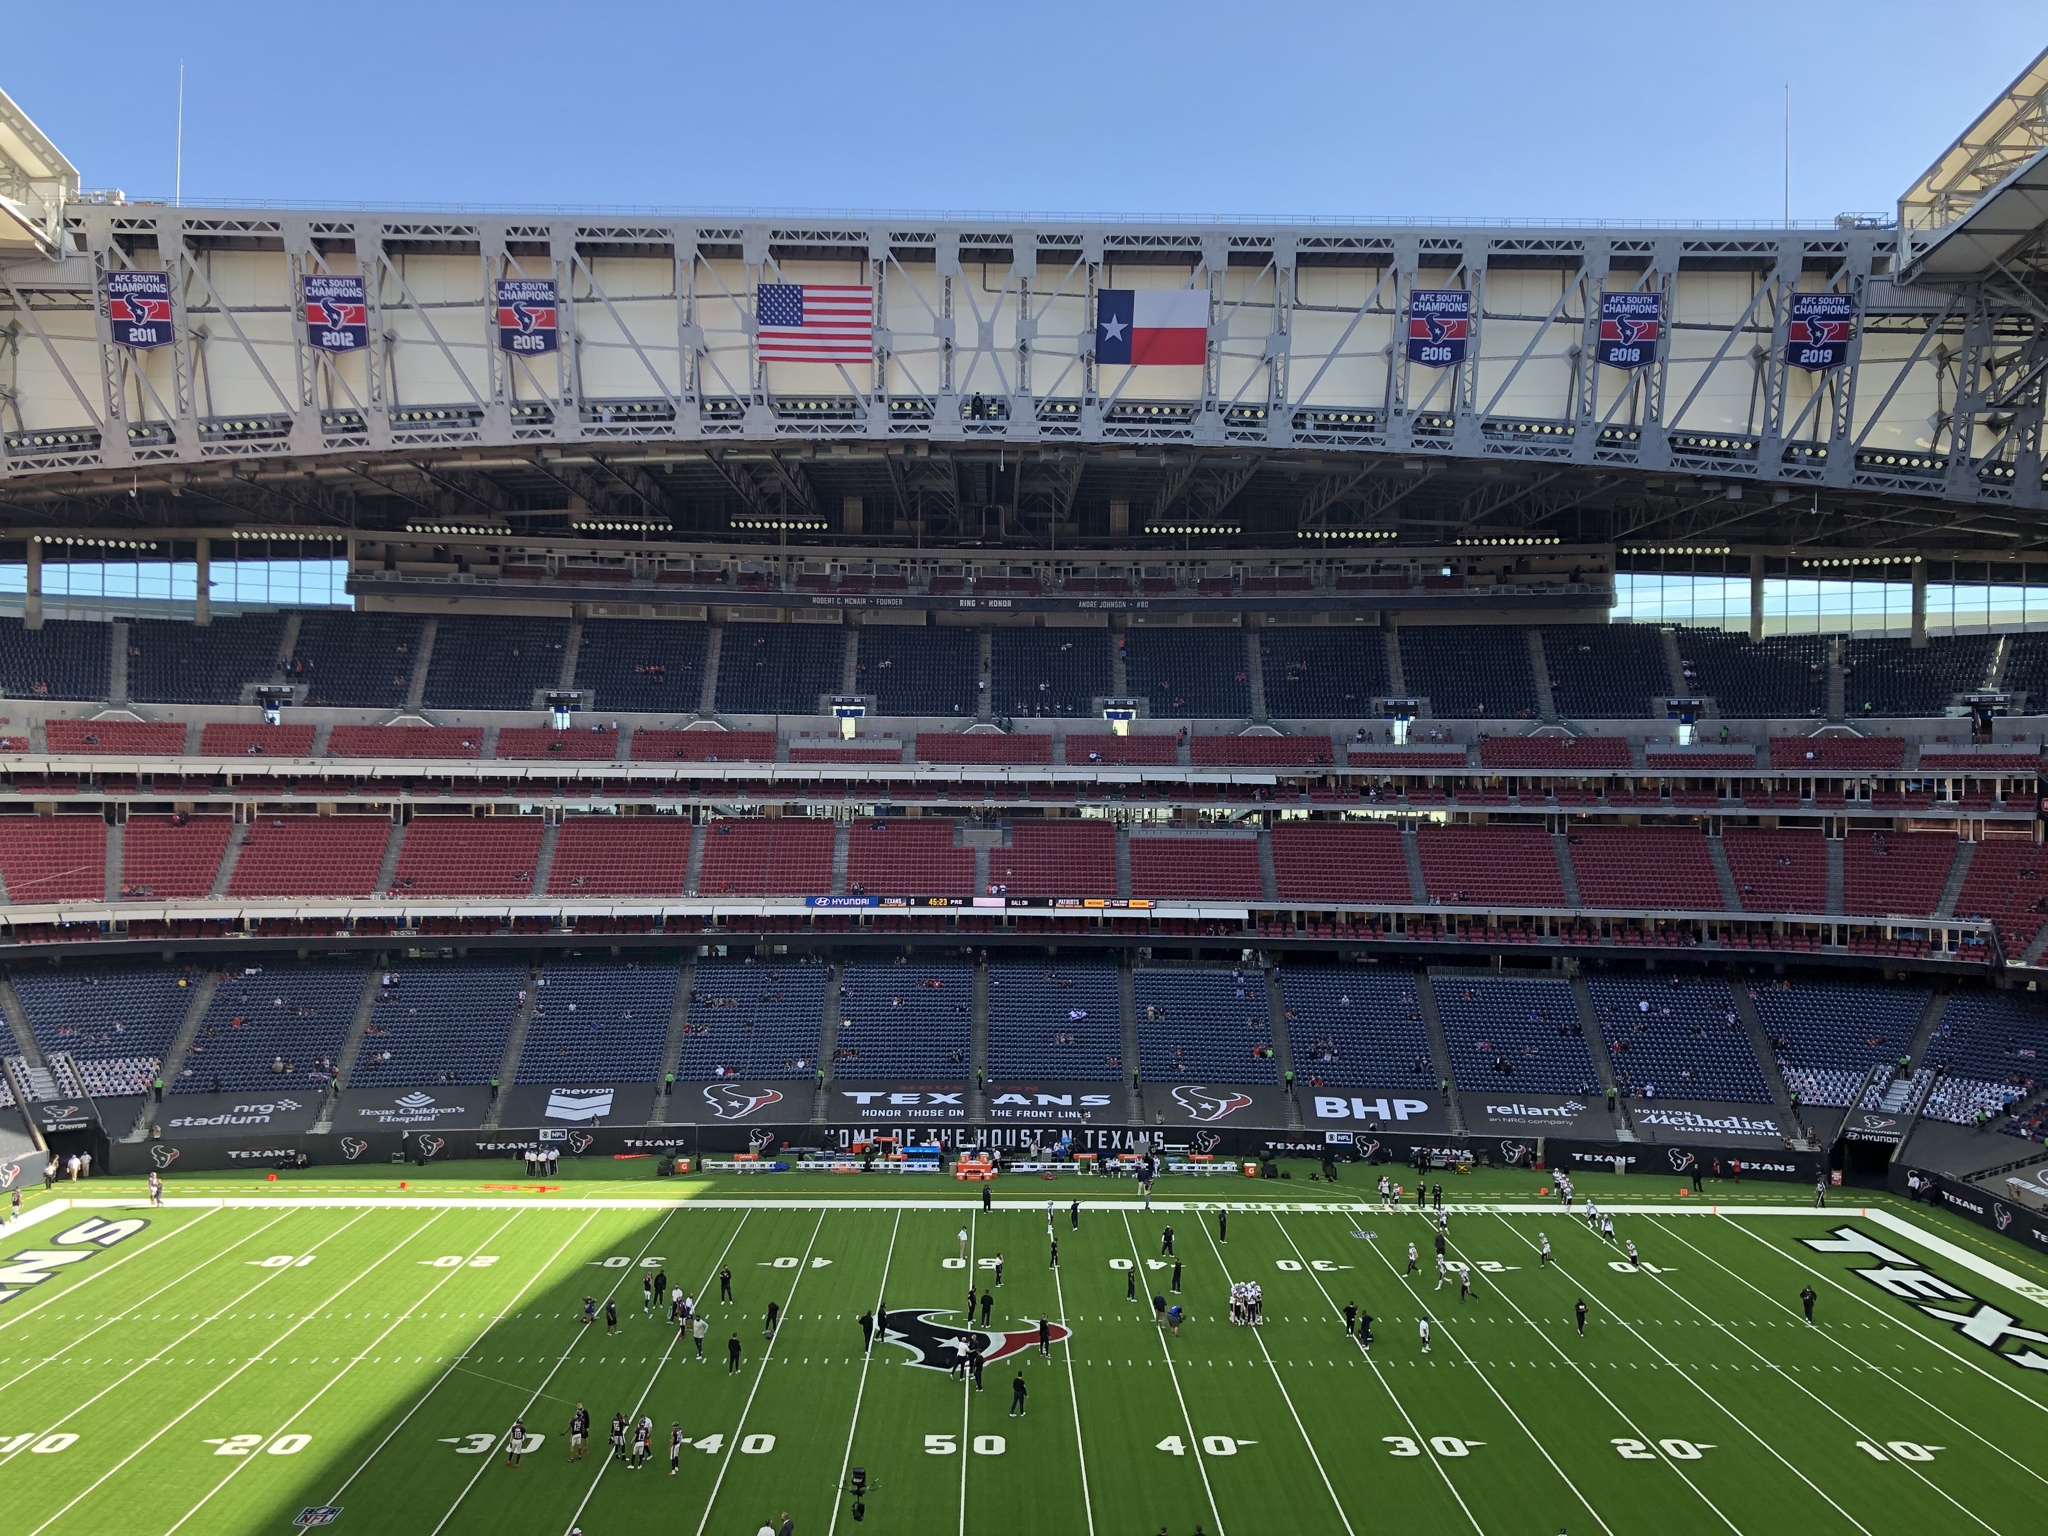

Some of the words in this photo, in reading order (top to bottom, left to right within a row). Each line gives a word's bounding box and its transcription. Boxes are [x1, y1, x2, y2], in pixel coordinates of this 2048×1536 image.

[110, 283, 166, 293] CHAMPIONS
[306, 286, 362, 297] CHAMPIONS
[498, 291, 554, 300] CHAMPIONS
[1413, 302, 1468, 312] CHAMPIONS
[1603, 304, 1658, 313] CHAMPIONS
[1794, 305, 1850, 314] CHAMPIONS
[128, 328, 157, 342] 2011
[322, 332, 354, 346] 2012
[513, 335, 545, 350] 2015
[1421, 347, 1452, 360] 2016
[1610, 348, 1640, 361] 2018
[1800, 349, 1832, 363] 2019
[841, 1092, 964, 1104] TEX
[991, 1093, 1111, 1106] ANS
[234, 1104, 275, 1114] nrg
[398, 1106, 465, 1115] Children's
[1314, 1096, 1429, 1120] BHP
[1486, 1104, 1572, 1116] reliant
[169, 1114, 270, 1127] stadium
[378, 1114, 436, 1123] Hospital
[1639, 1114, 1778, 1131] Methodist
[892, 1129, 916, 1147] OF
[977, 1129, 1072, 1148] HOUSTN
[1084, 1130, 1164, 1150] TEXANS
[228, 1149, 296, 1159] TEXANS
[1410, 1147, 1472, 1156] TXANS
[1572, 1153, 1636, 1163] TEXANS
[1942, 1190, 1984, 1214] TEXANS
[213, 1434, 312, 1455] 20
[455, 1434, 545, 1454] 30
[692, 1434, 776, 1454] 40
[924, 1434, 1006, 1455] 50
[1155, 1435, 1237, 1456] 40
[1382, 1436, 1469, 1456] 30
[1610, 1439, 1703, 1459] 20
[1856, 1441, 1935, 1461] 10
[298, 1514, 330, 1524] NFL
